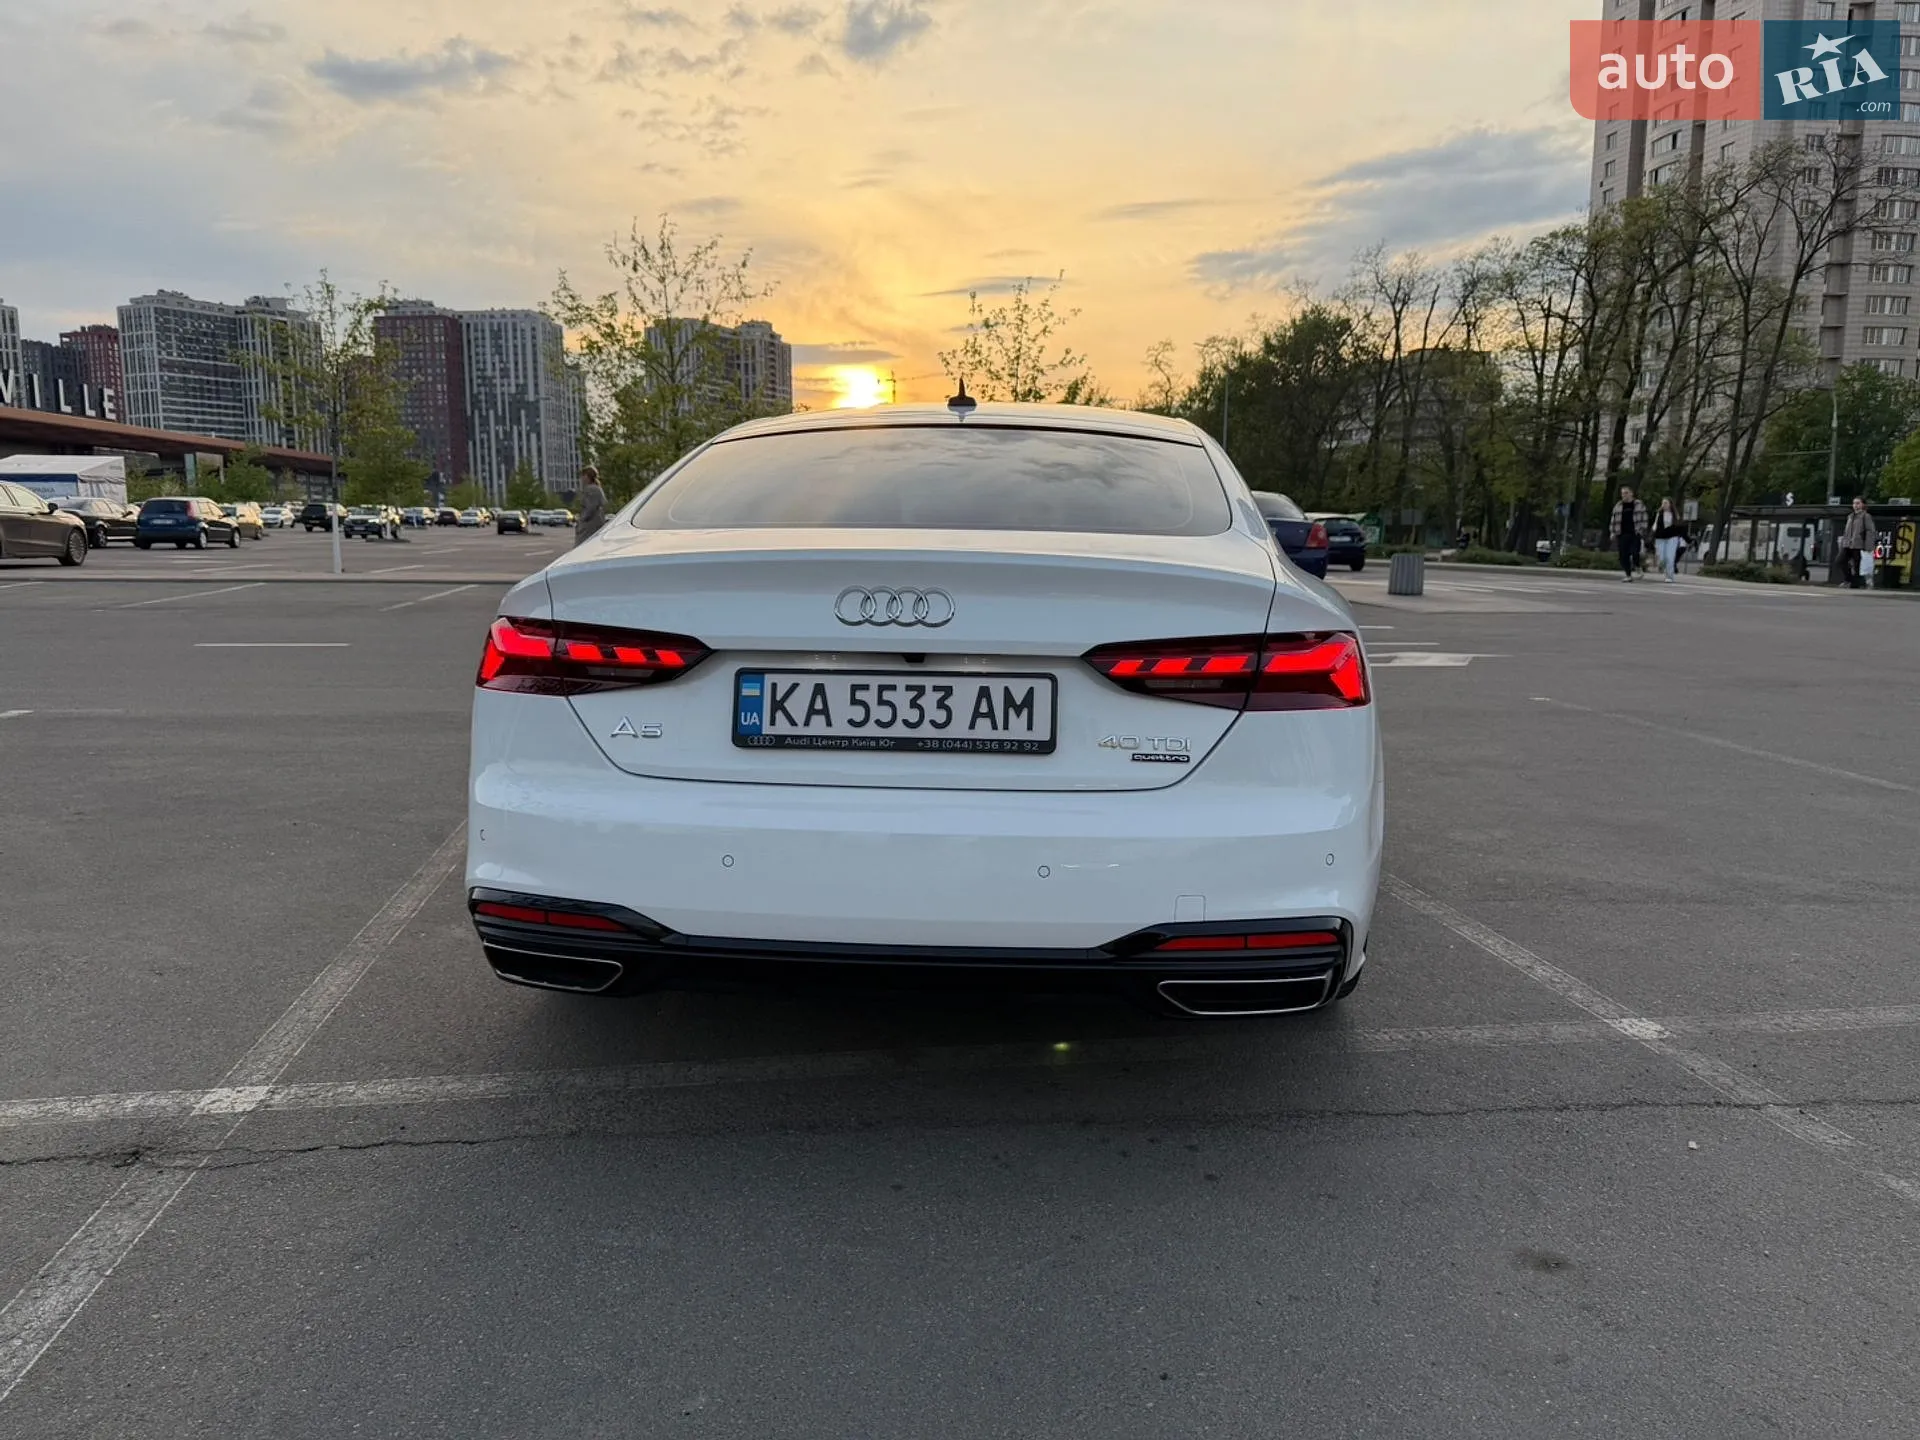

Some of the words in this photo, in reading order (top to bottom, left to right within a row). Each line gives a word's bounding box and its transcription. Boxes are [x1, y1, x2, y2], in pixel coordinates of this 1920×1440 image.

[0, 369, 117, 420] VILLE
[769, 682, 833, 727] KA
[846, 684, 953, 729] 5533
[968, 685, 1034, 731] AM
[741, 711, 760, 726] UA
[609, 716, 663, 738] A5
[784, 736, 811, 746] Audi
[813, 738, 848, 748] Центр
[851, 738, 876, 747] Київ
[879, 739, 896, 747] Юг
[917, 739, 939, 749] +38
[942, 740, 973, 750] (044)
[976, 741, 999, 750] 536
[1003, 741, 1019, 750] 92
[1023, 742, 1039, 751] 92
[1098, 735, 1139, 750] 40
[1146, 737, 1191, 752] TDI
[1132, 754, 1189, 762] quattro
